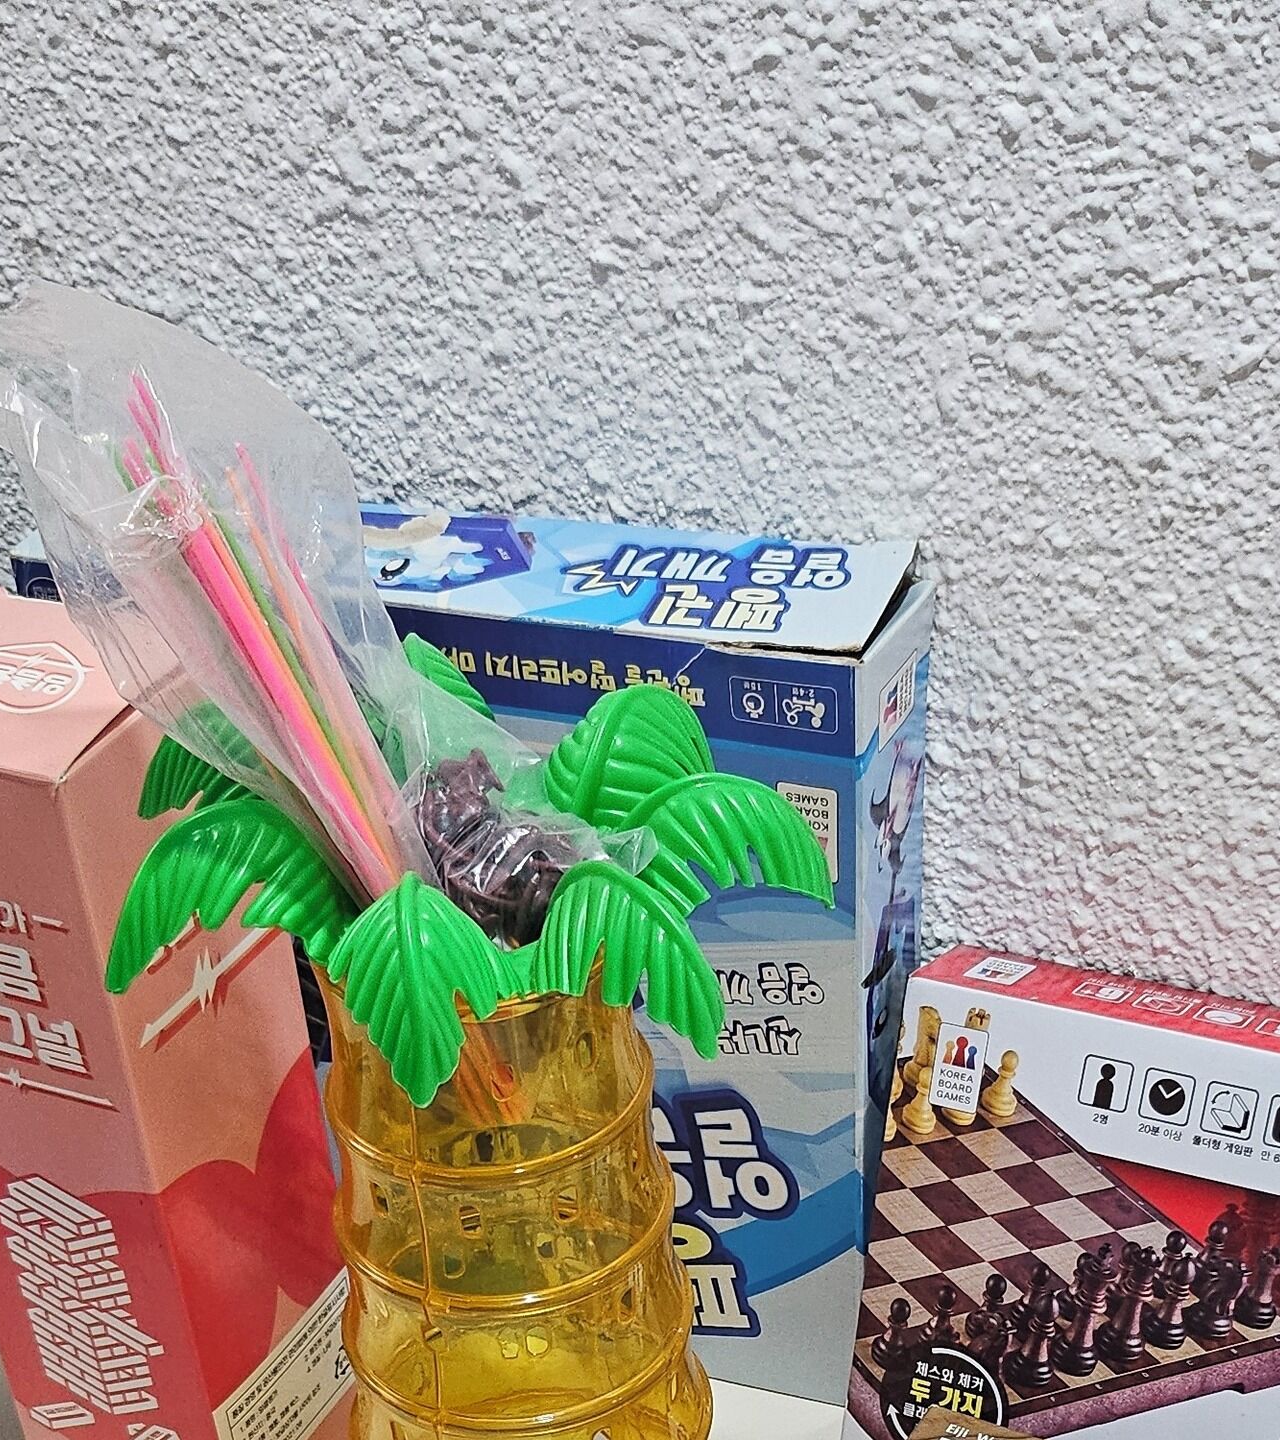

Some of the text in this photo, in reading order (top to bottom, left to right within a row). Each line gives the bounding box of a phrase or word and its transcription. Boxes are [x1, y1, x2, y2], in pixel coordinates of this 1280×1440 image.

[610, 547, 850, 590] 얼음 깨기
[645, 584, 785, 632] 펭귄
[485, 652, 615, 691] 떨어뜨리지
[786, 792, 829, 807] GAMES
[796, 806, 829, 820] BOAR
[757, 962, 824, 1005] 얼음
[940, 1068, 974, 1083] KOREA
[938, 1079, 972, 1094] BOARD
[936, 1090, 971, 1105] GAMES
[1092, 1113, 1109, 1125] 2명
[1138, 1123, 1183, 1142] 20분 이상
[1223, 1143, 1254, 1158] 게임판
[1260, 1150, 1271, 1162] 만
[915, 1361, 984, 1392] 체스와 체커
[909, 1377, 984, 1419] 두 가지
